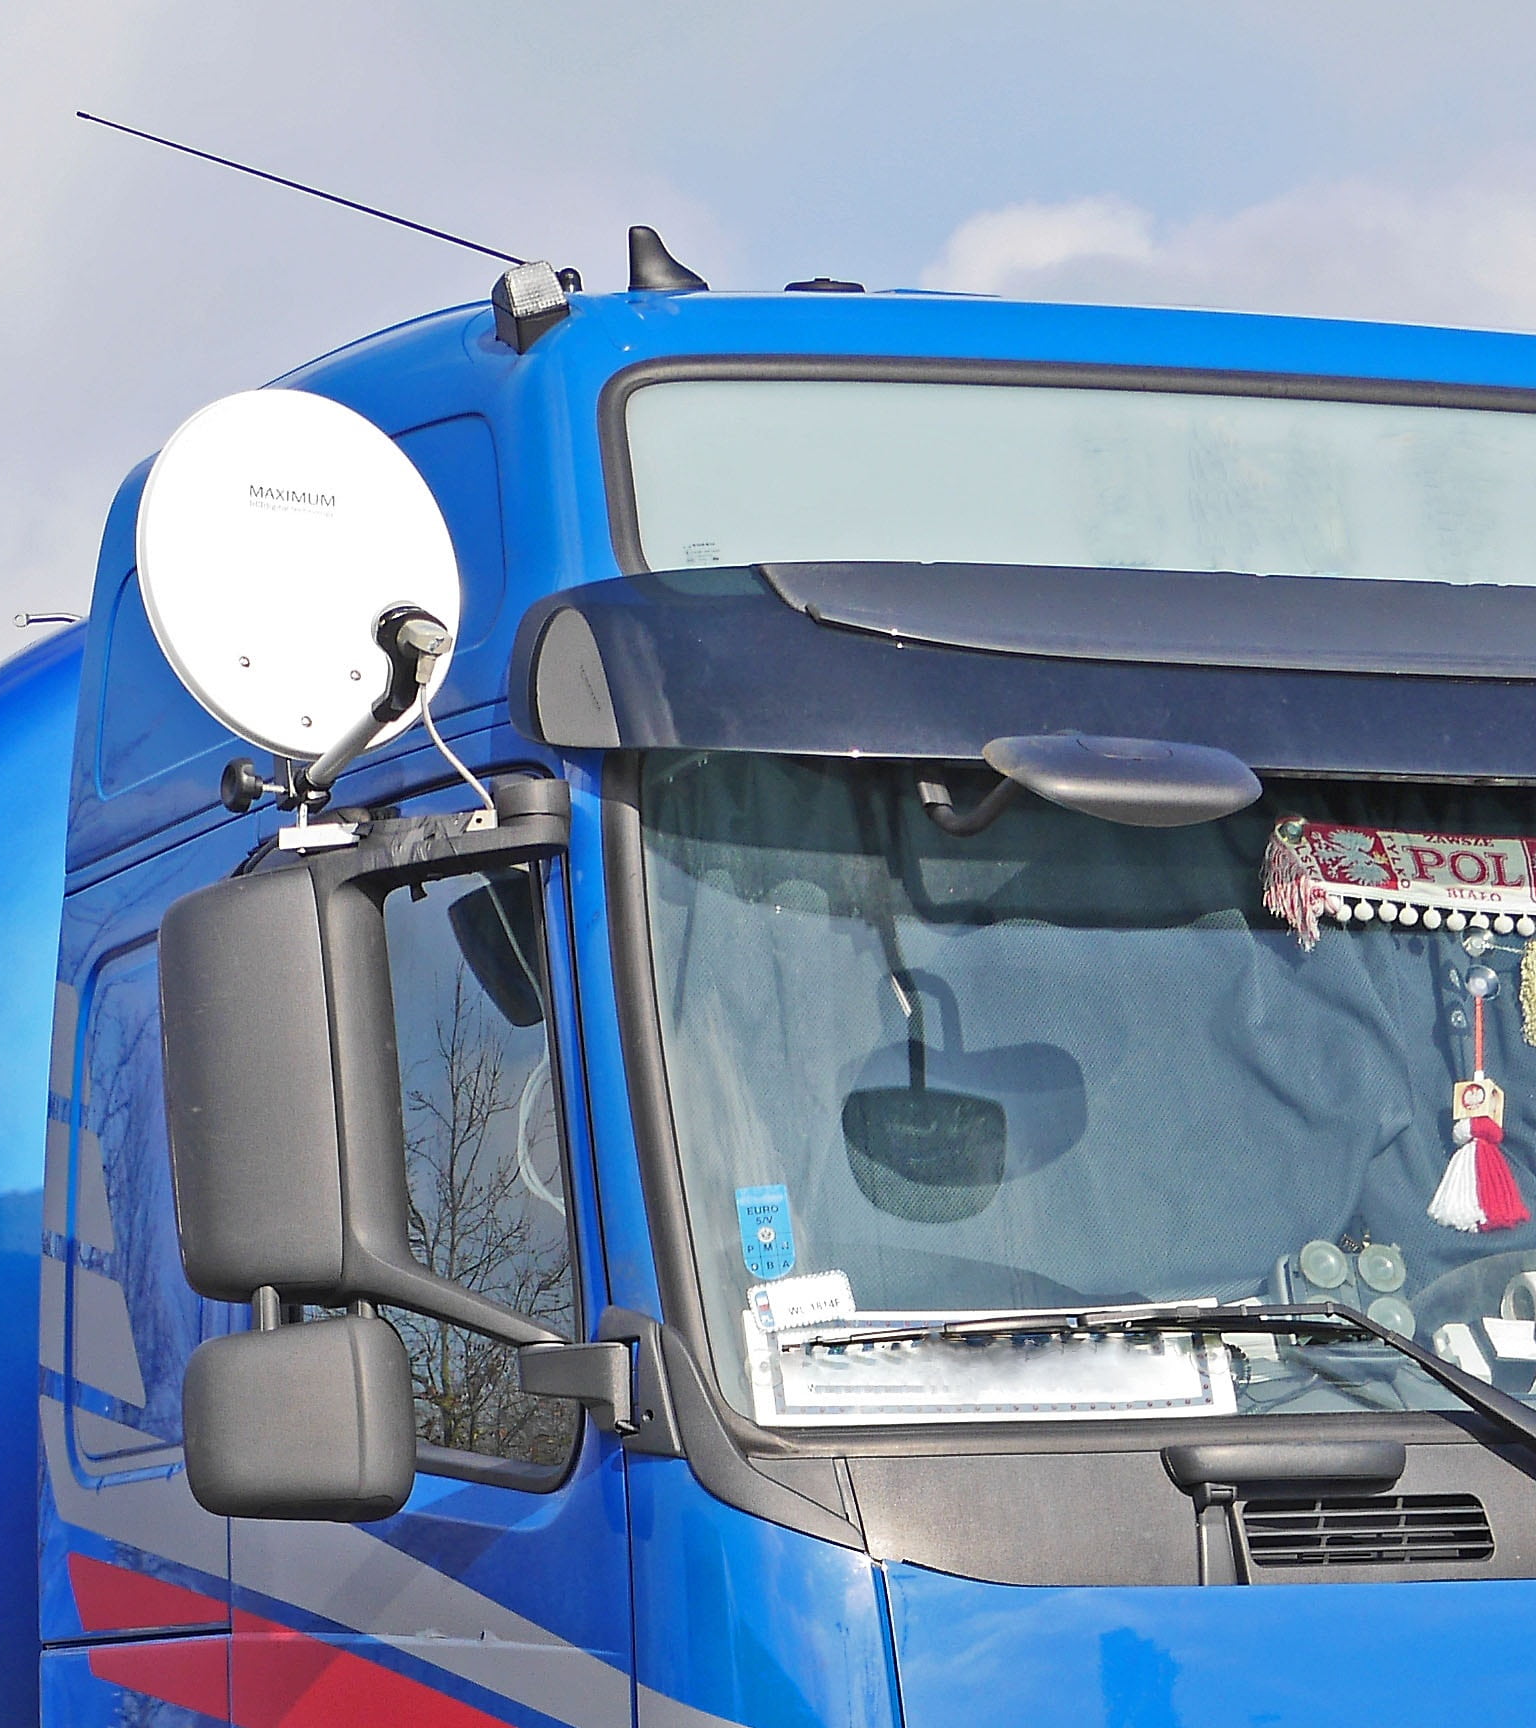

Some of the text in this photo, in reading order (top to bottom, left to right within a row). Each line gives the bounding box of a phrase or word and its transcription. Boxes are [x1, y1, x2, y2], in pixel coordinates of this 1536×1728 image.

[249, 484, 335, 507] MAXIMUM
[1401, 845, 1526, 889] POL
[746, 1204, 780, 1216] EURO
